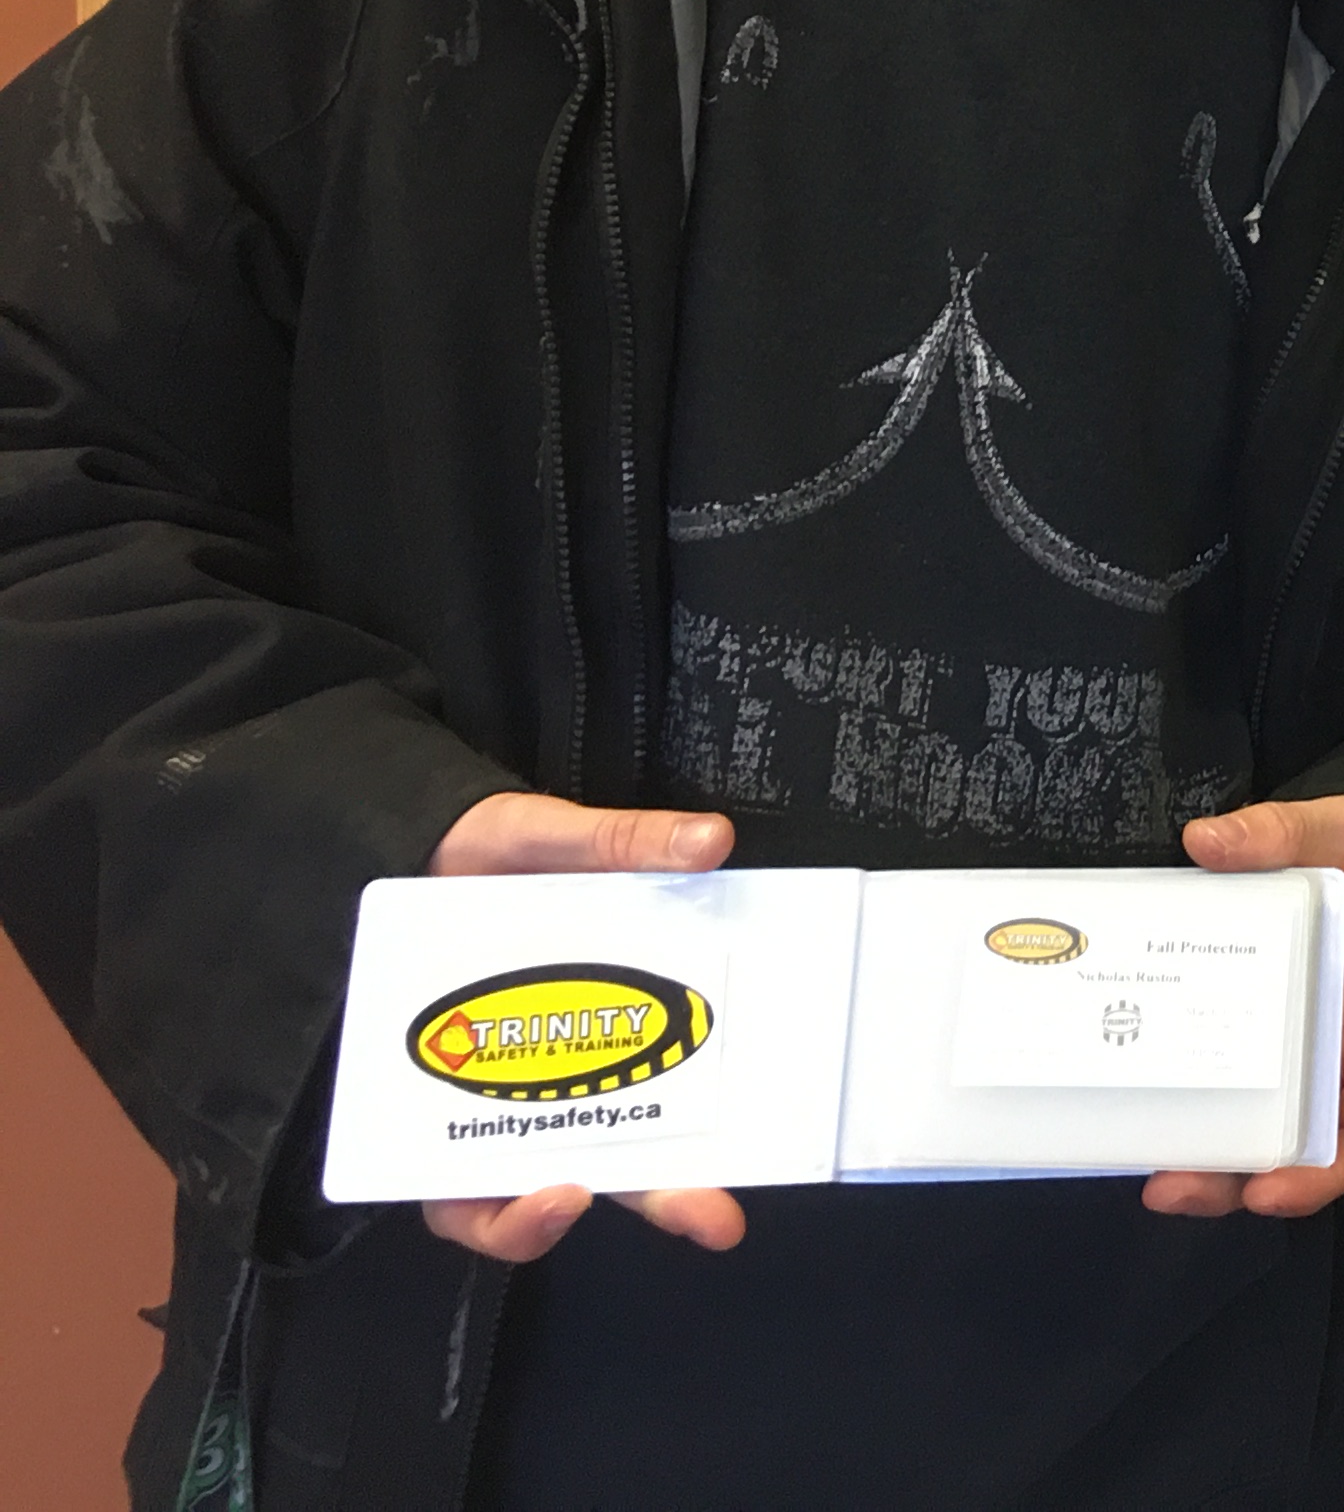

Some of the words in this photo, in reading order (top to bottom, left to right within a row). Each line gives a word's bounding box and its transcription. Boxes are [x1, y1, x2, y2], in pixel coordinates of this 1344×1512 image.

[1006, 931, 1069, 946] TRINITY
[1146, 940, 1175, 954] Fall
[1180, 941, 1257, 955] Protection
[471, 1002, 652, 1052] TRINITY
[1101, 1017, 1144, 1028] TRINITY
[475, 1048, 539, 1064] SAFETY
[546, 1044, 557, 1056] &
[564, 1034, 645, 1055] TRAINING
[447, 1102, 662, 1141] trinitysafety.ca
